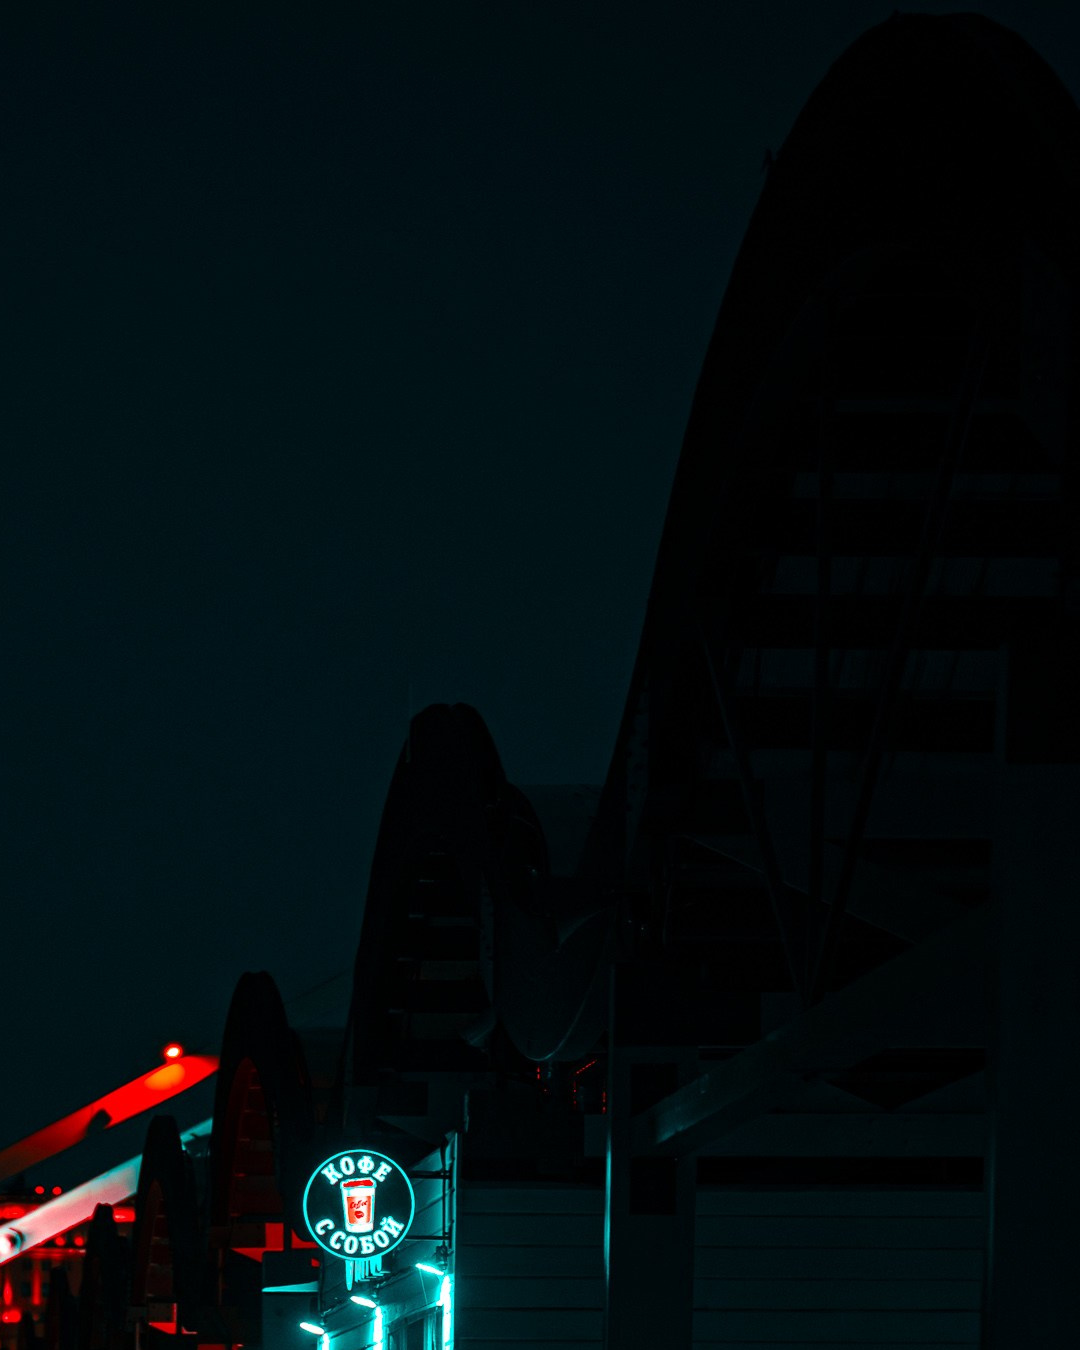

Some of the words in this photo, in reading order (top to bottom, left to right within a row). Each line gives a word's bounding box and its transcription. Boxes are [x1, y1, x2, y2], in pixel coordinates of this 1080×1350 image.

[321, 1155, 392, 1185] КОФЕ
[315, 1218, 335, 1235] С
[329, 1216, 404, 1254] СОБОЙ
